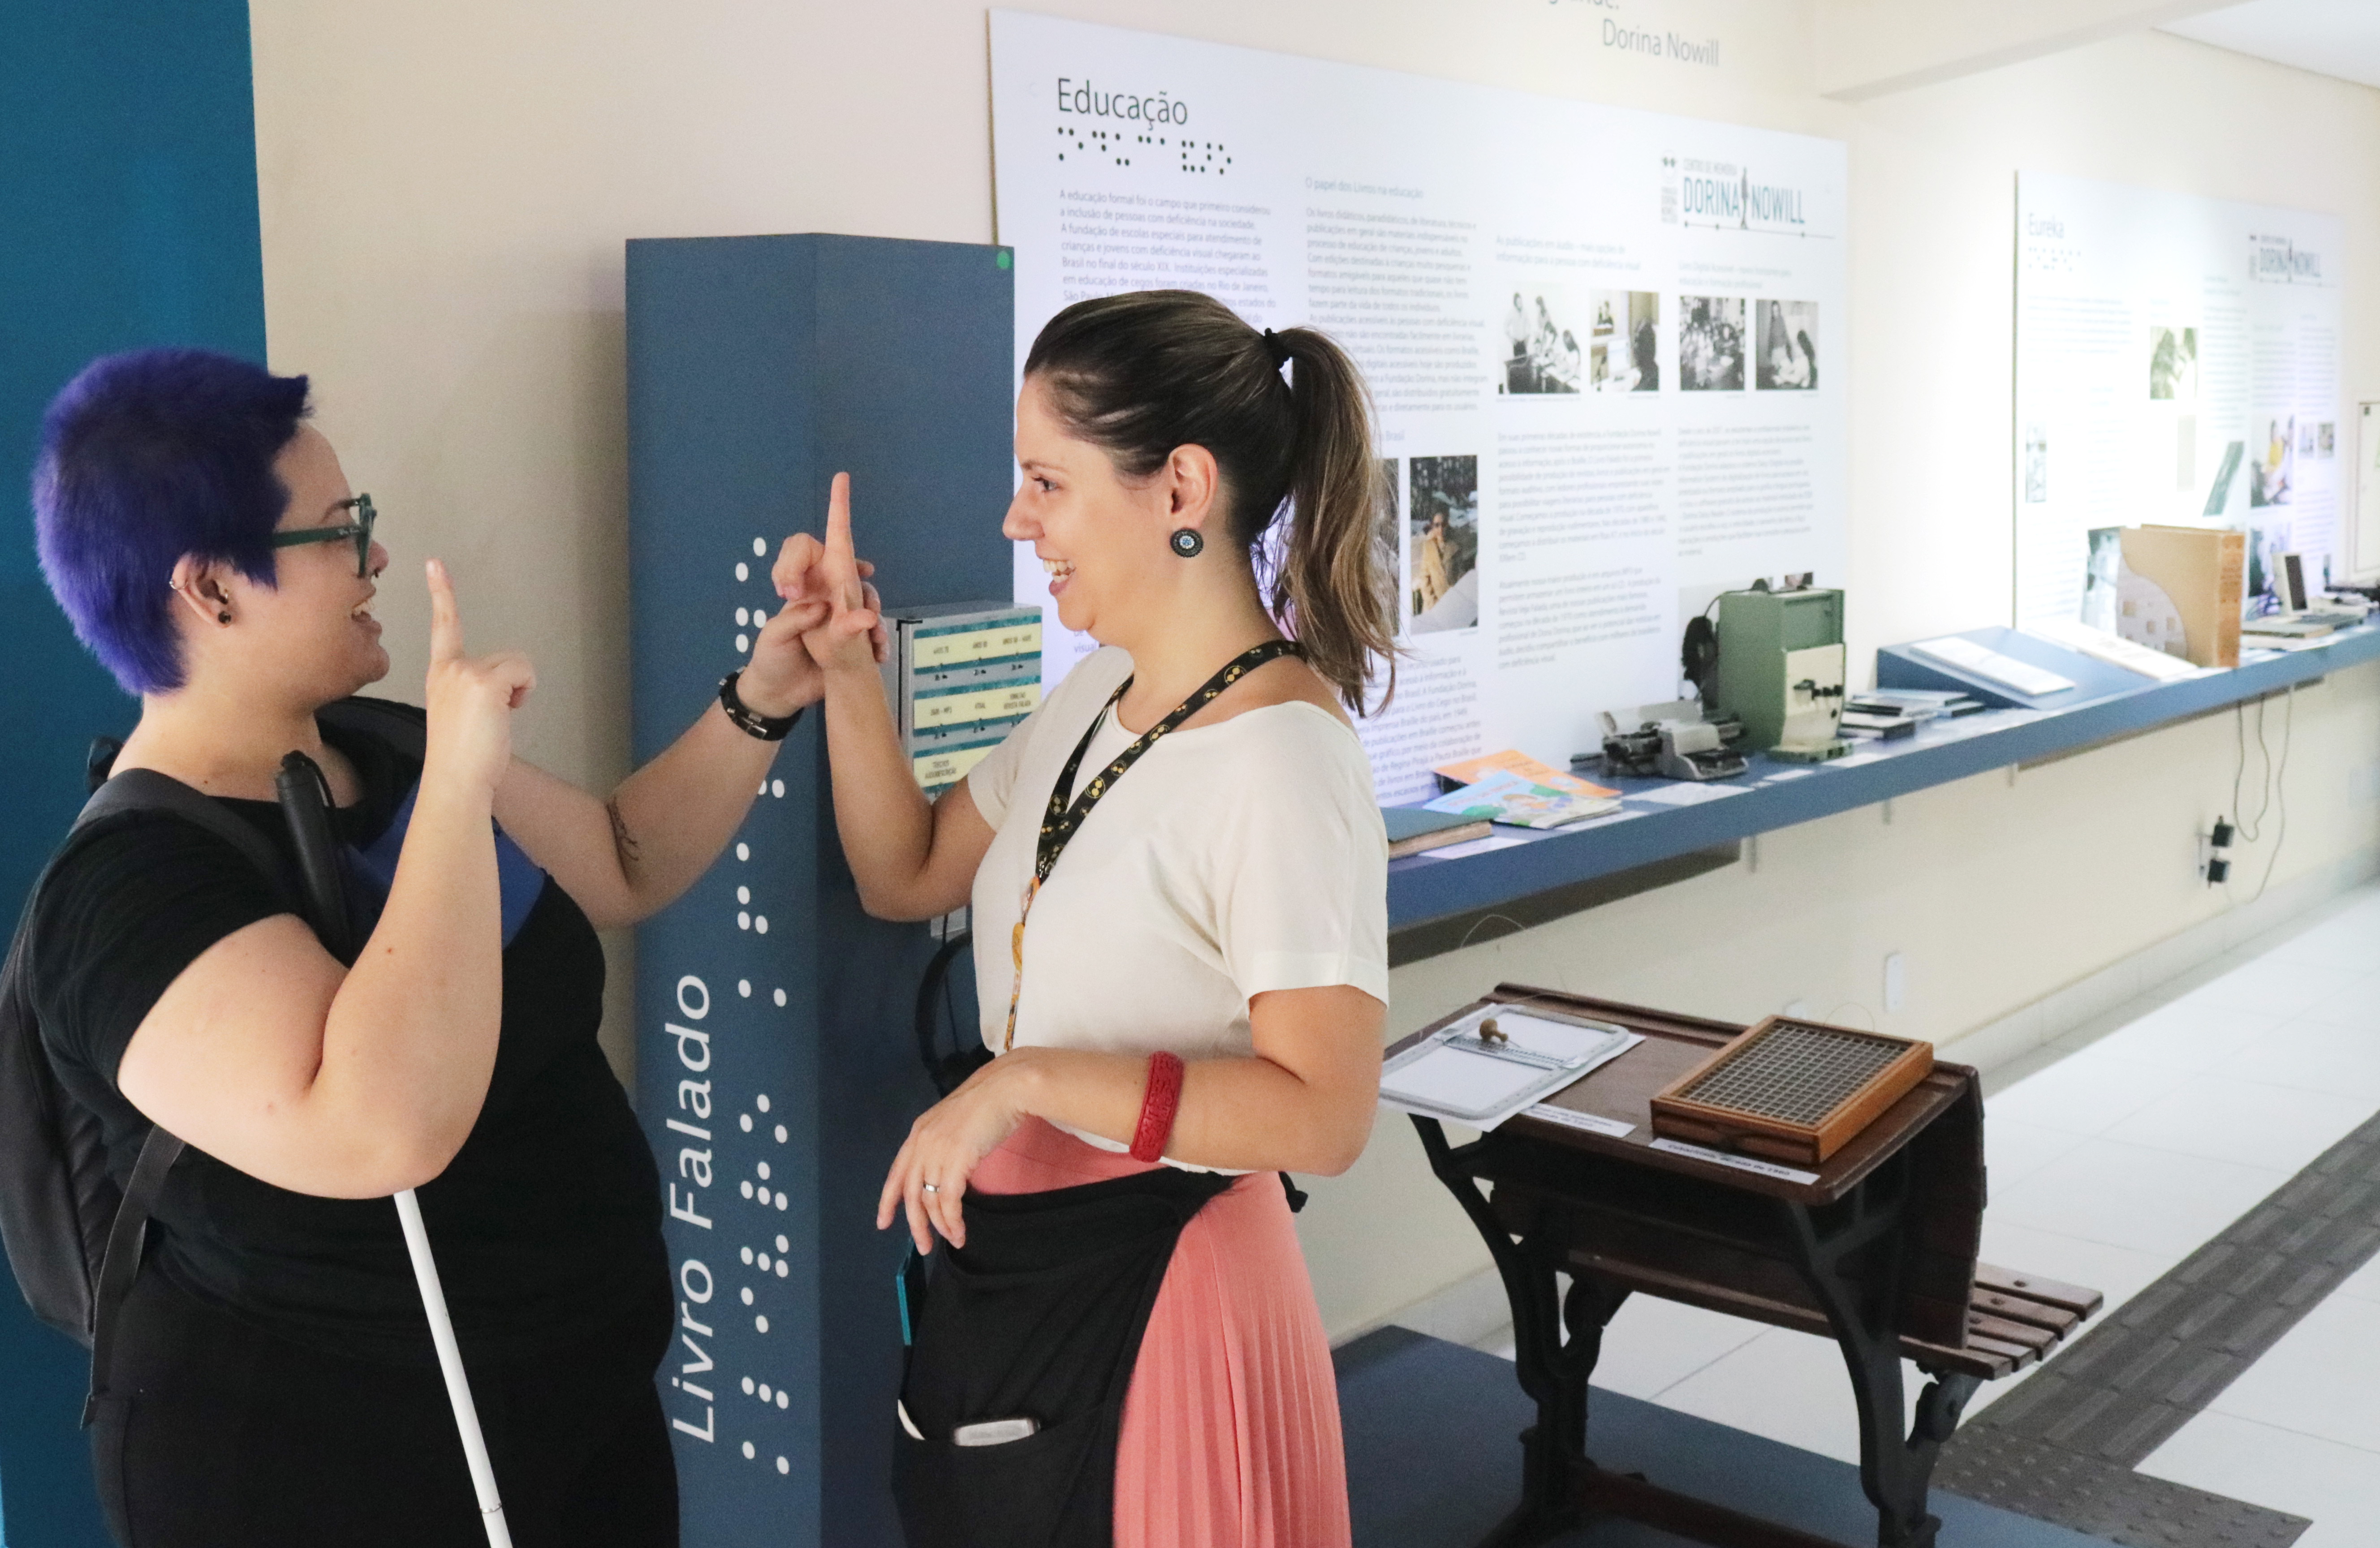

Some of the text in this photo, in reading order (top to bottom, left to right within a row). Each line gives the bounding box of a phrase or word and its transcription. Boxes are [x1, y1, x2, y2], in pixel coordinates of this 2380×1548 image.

[1604, 18, 1719, 66] Dorina Nowill
[1058, 78, 1188, 130] Educação
[1684, 177, 1740, 217] DORINA
[1752, 185, 1805, 224] NOWILL
[2028, 213, 2065, 239] Eureka
[665, 974, 715, 1443] Livro Falado
